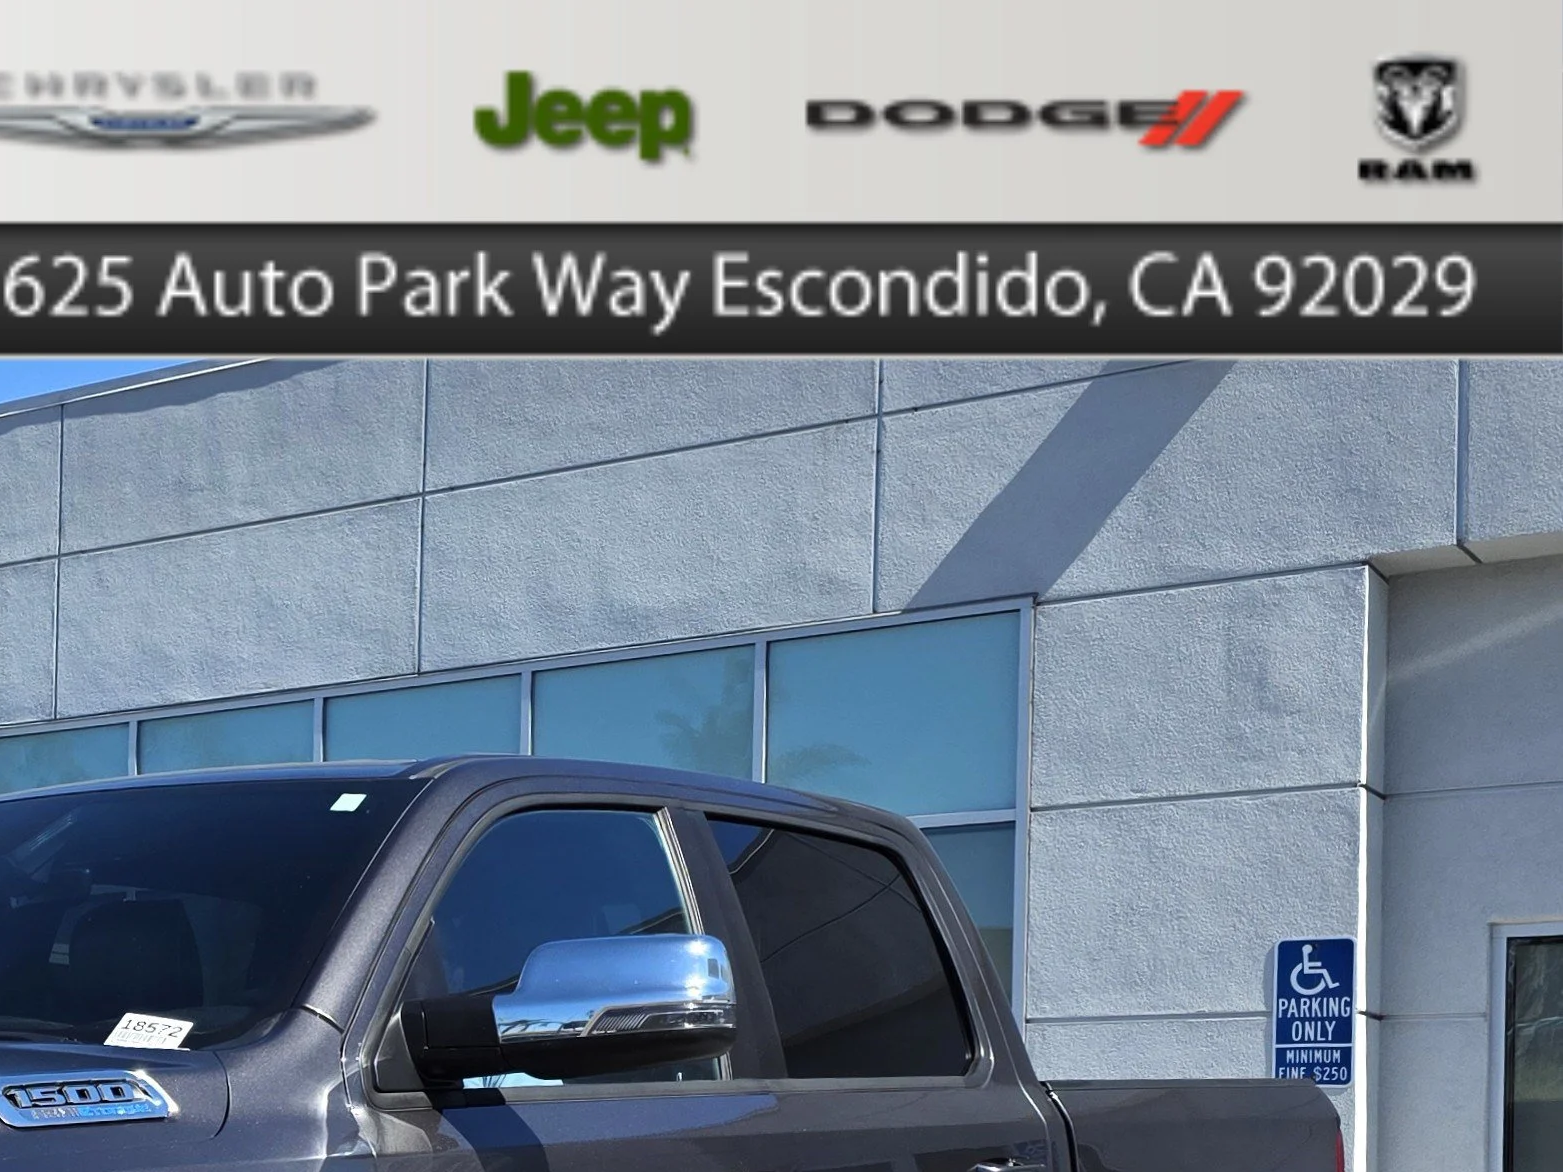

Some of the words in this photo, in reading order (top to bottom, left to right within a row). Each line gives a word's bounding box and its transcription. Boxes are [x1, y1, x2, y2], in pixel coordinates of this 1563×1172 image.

[1278, 996, 1351, 1018] PARKING
[121, 1019, 183, 1038] 18572
[1292, 1021, 1336, 1041] ONLY
[1286, 1050, 1341, 1063] MINIMUM
[1278, 1066, 1307, 1079] FINE
[1313, 1065, 1348, 1081] $250
[4, 1081, 138, 1109] 1500
